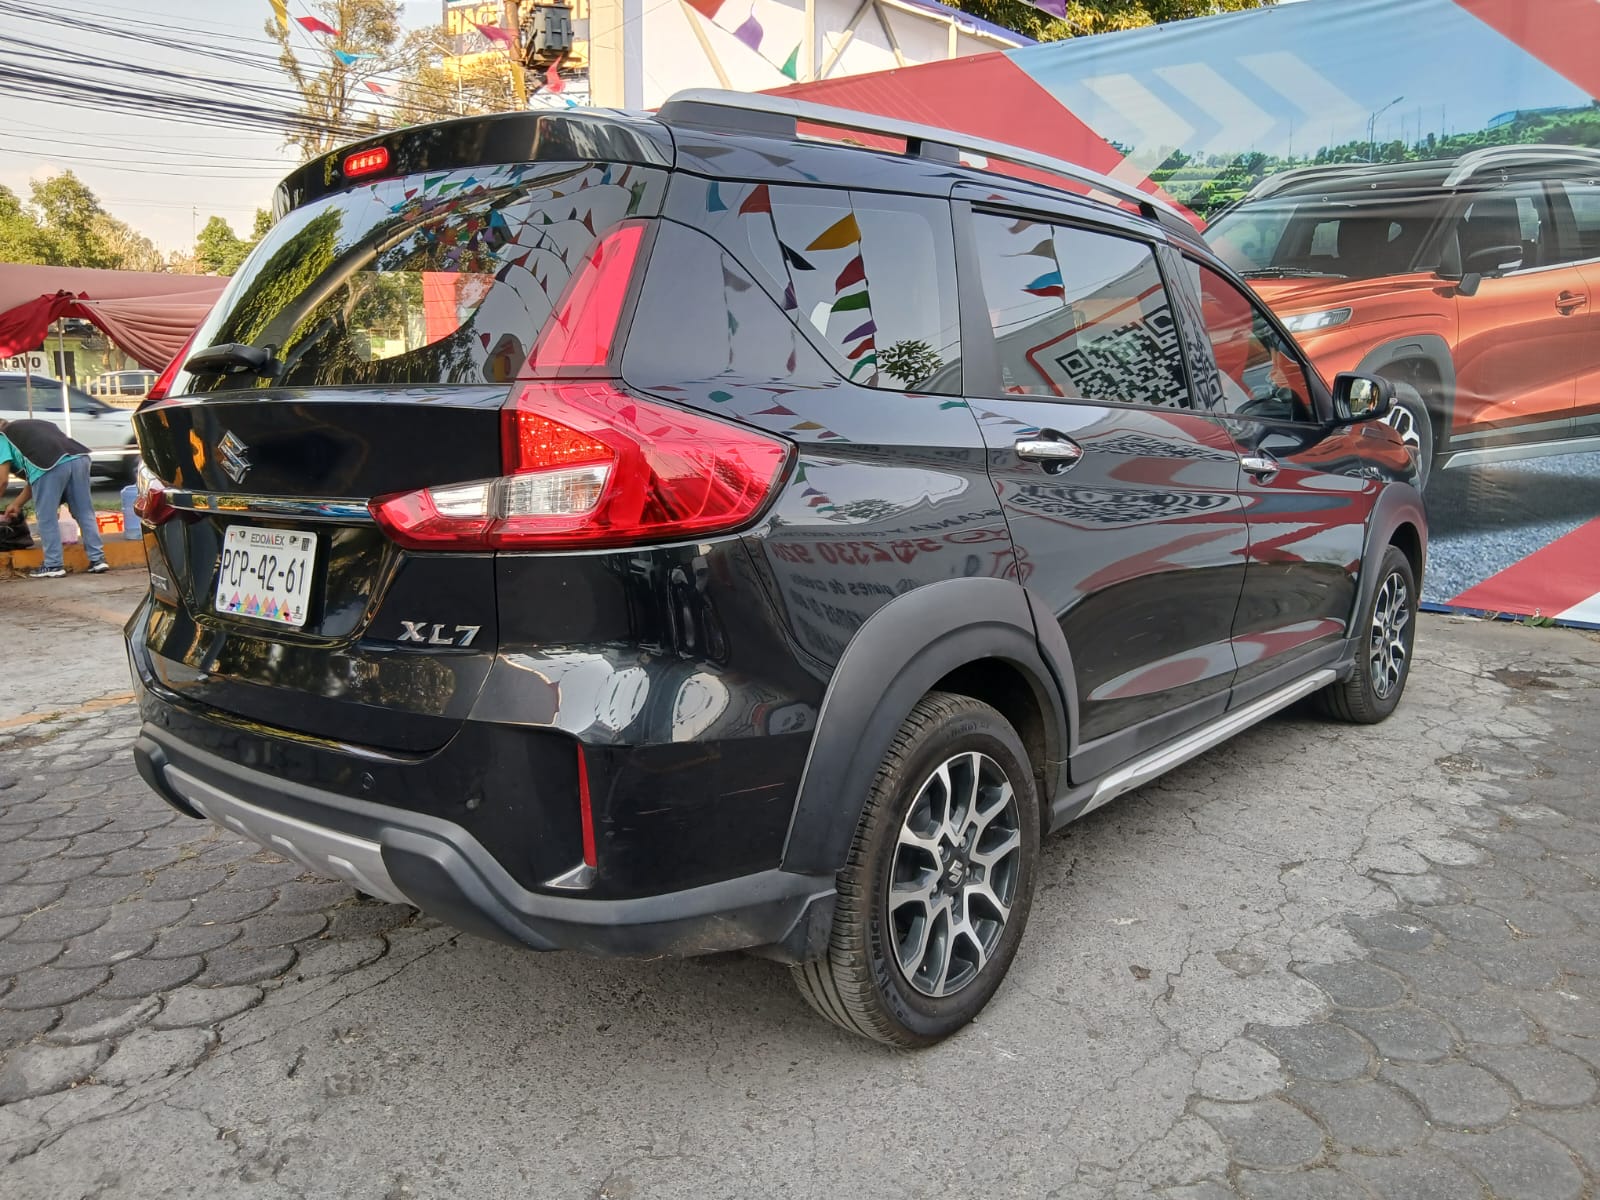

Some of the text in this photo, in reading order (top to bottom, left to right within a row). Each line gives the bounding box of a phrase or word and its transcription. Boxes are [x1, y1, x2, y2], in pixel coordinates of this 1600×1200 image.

[0, 357, 41, 369] ravo
[220, 549, 307, 594] PCP-42-61
[398, 620, 482, 646] XL7
